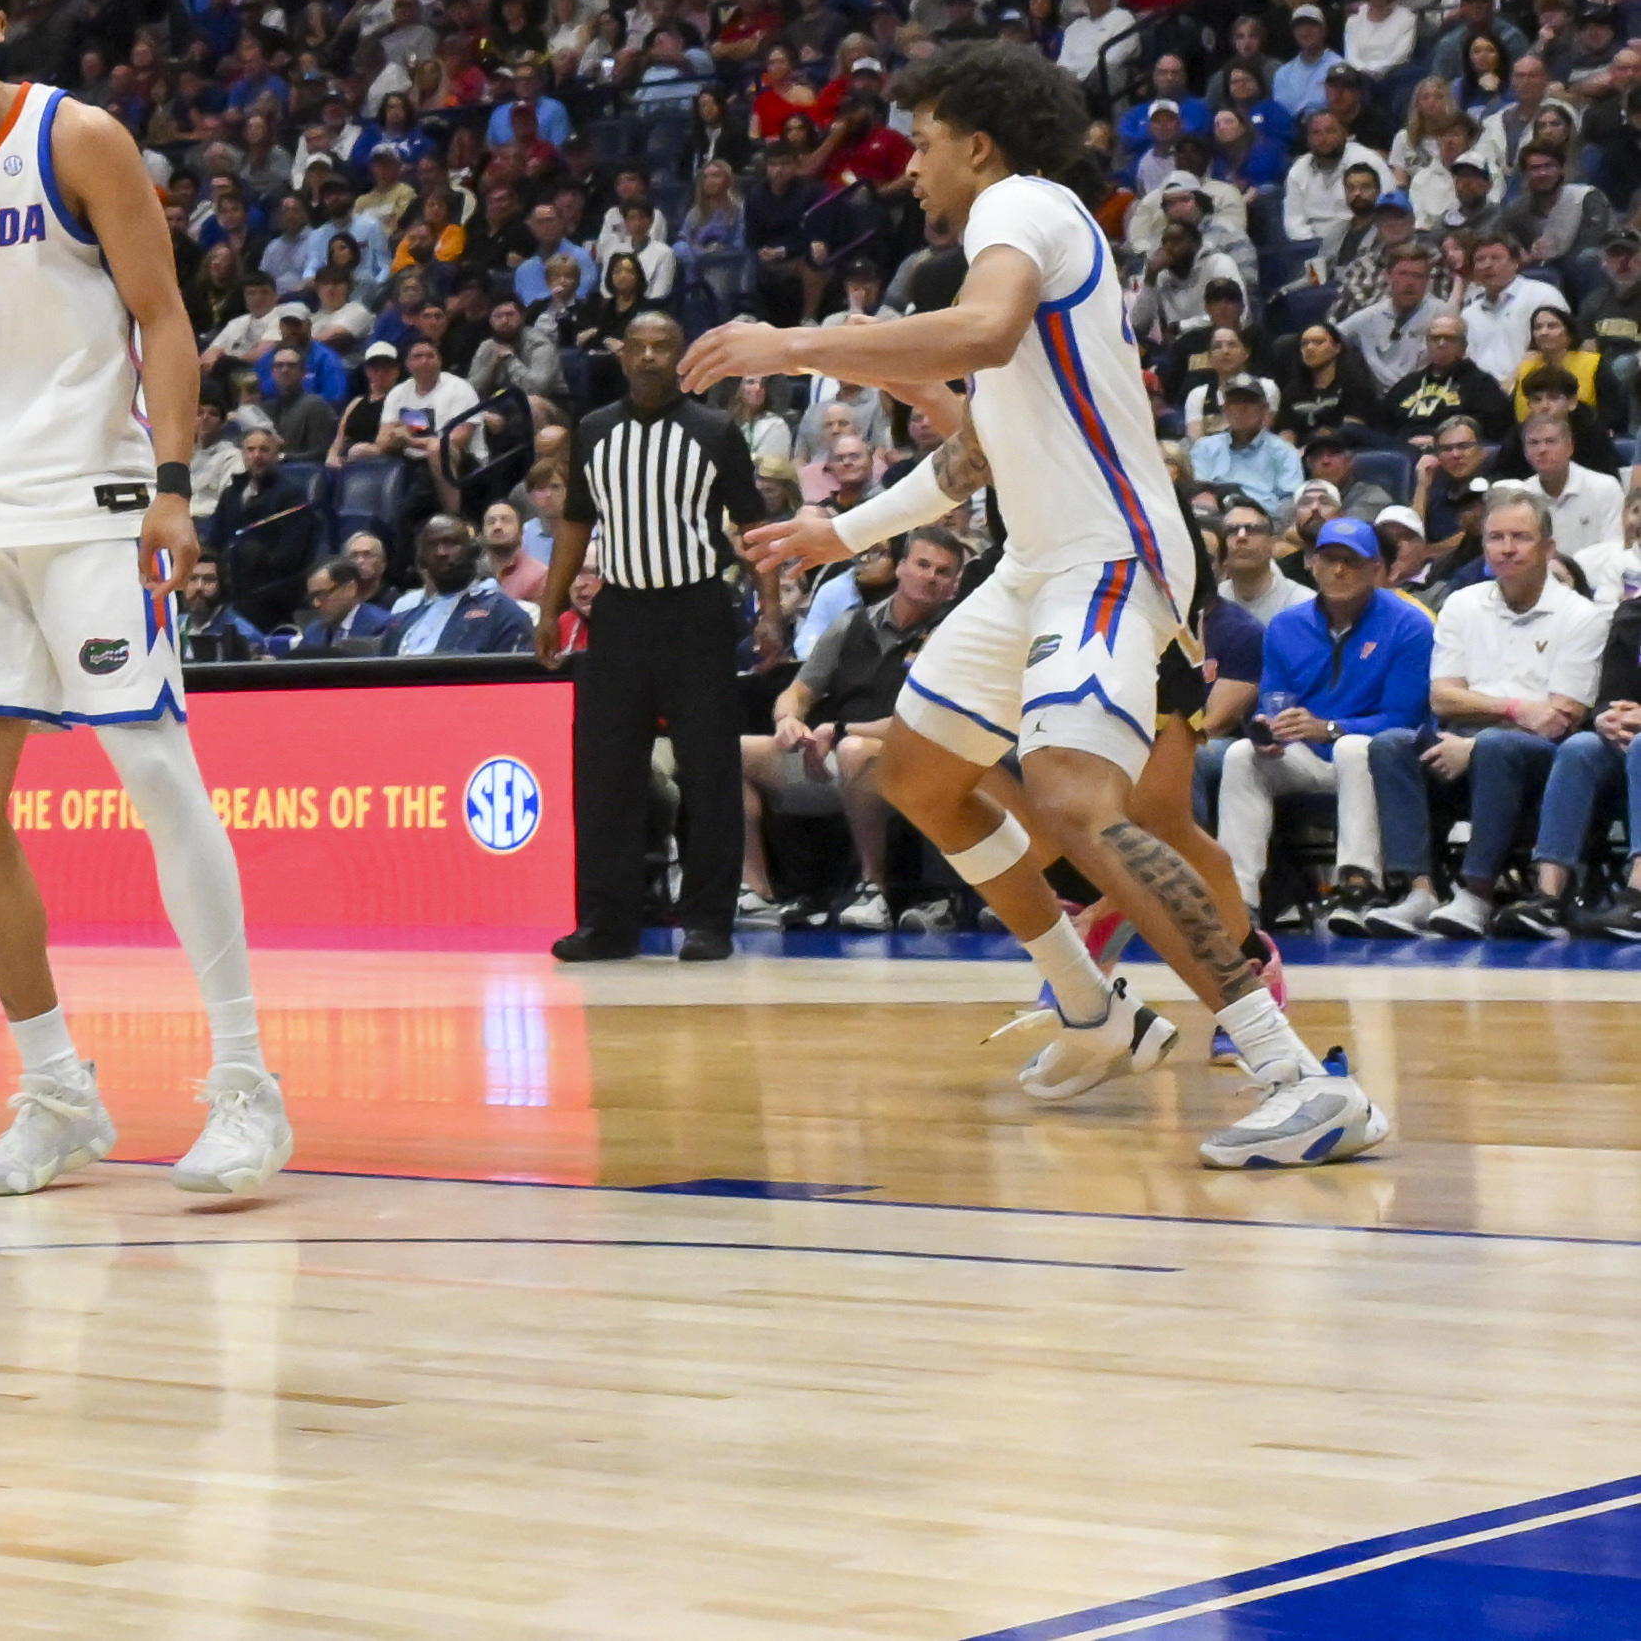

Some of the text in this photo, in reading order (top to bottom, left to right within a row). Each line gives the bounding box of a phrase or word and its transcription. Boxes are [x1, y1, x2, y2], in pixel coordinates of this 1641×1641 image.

[9, 785, 447, 830] HE OFFI BEANS OF THE
[468, 761, 539, 848] SEC
